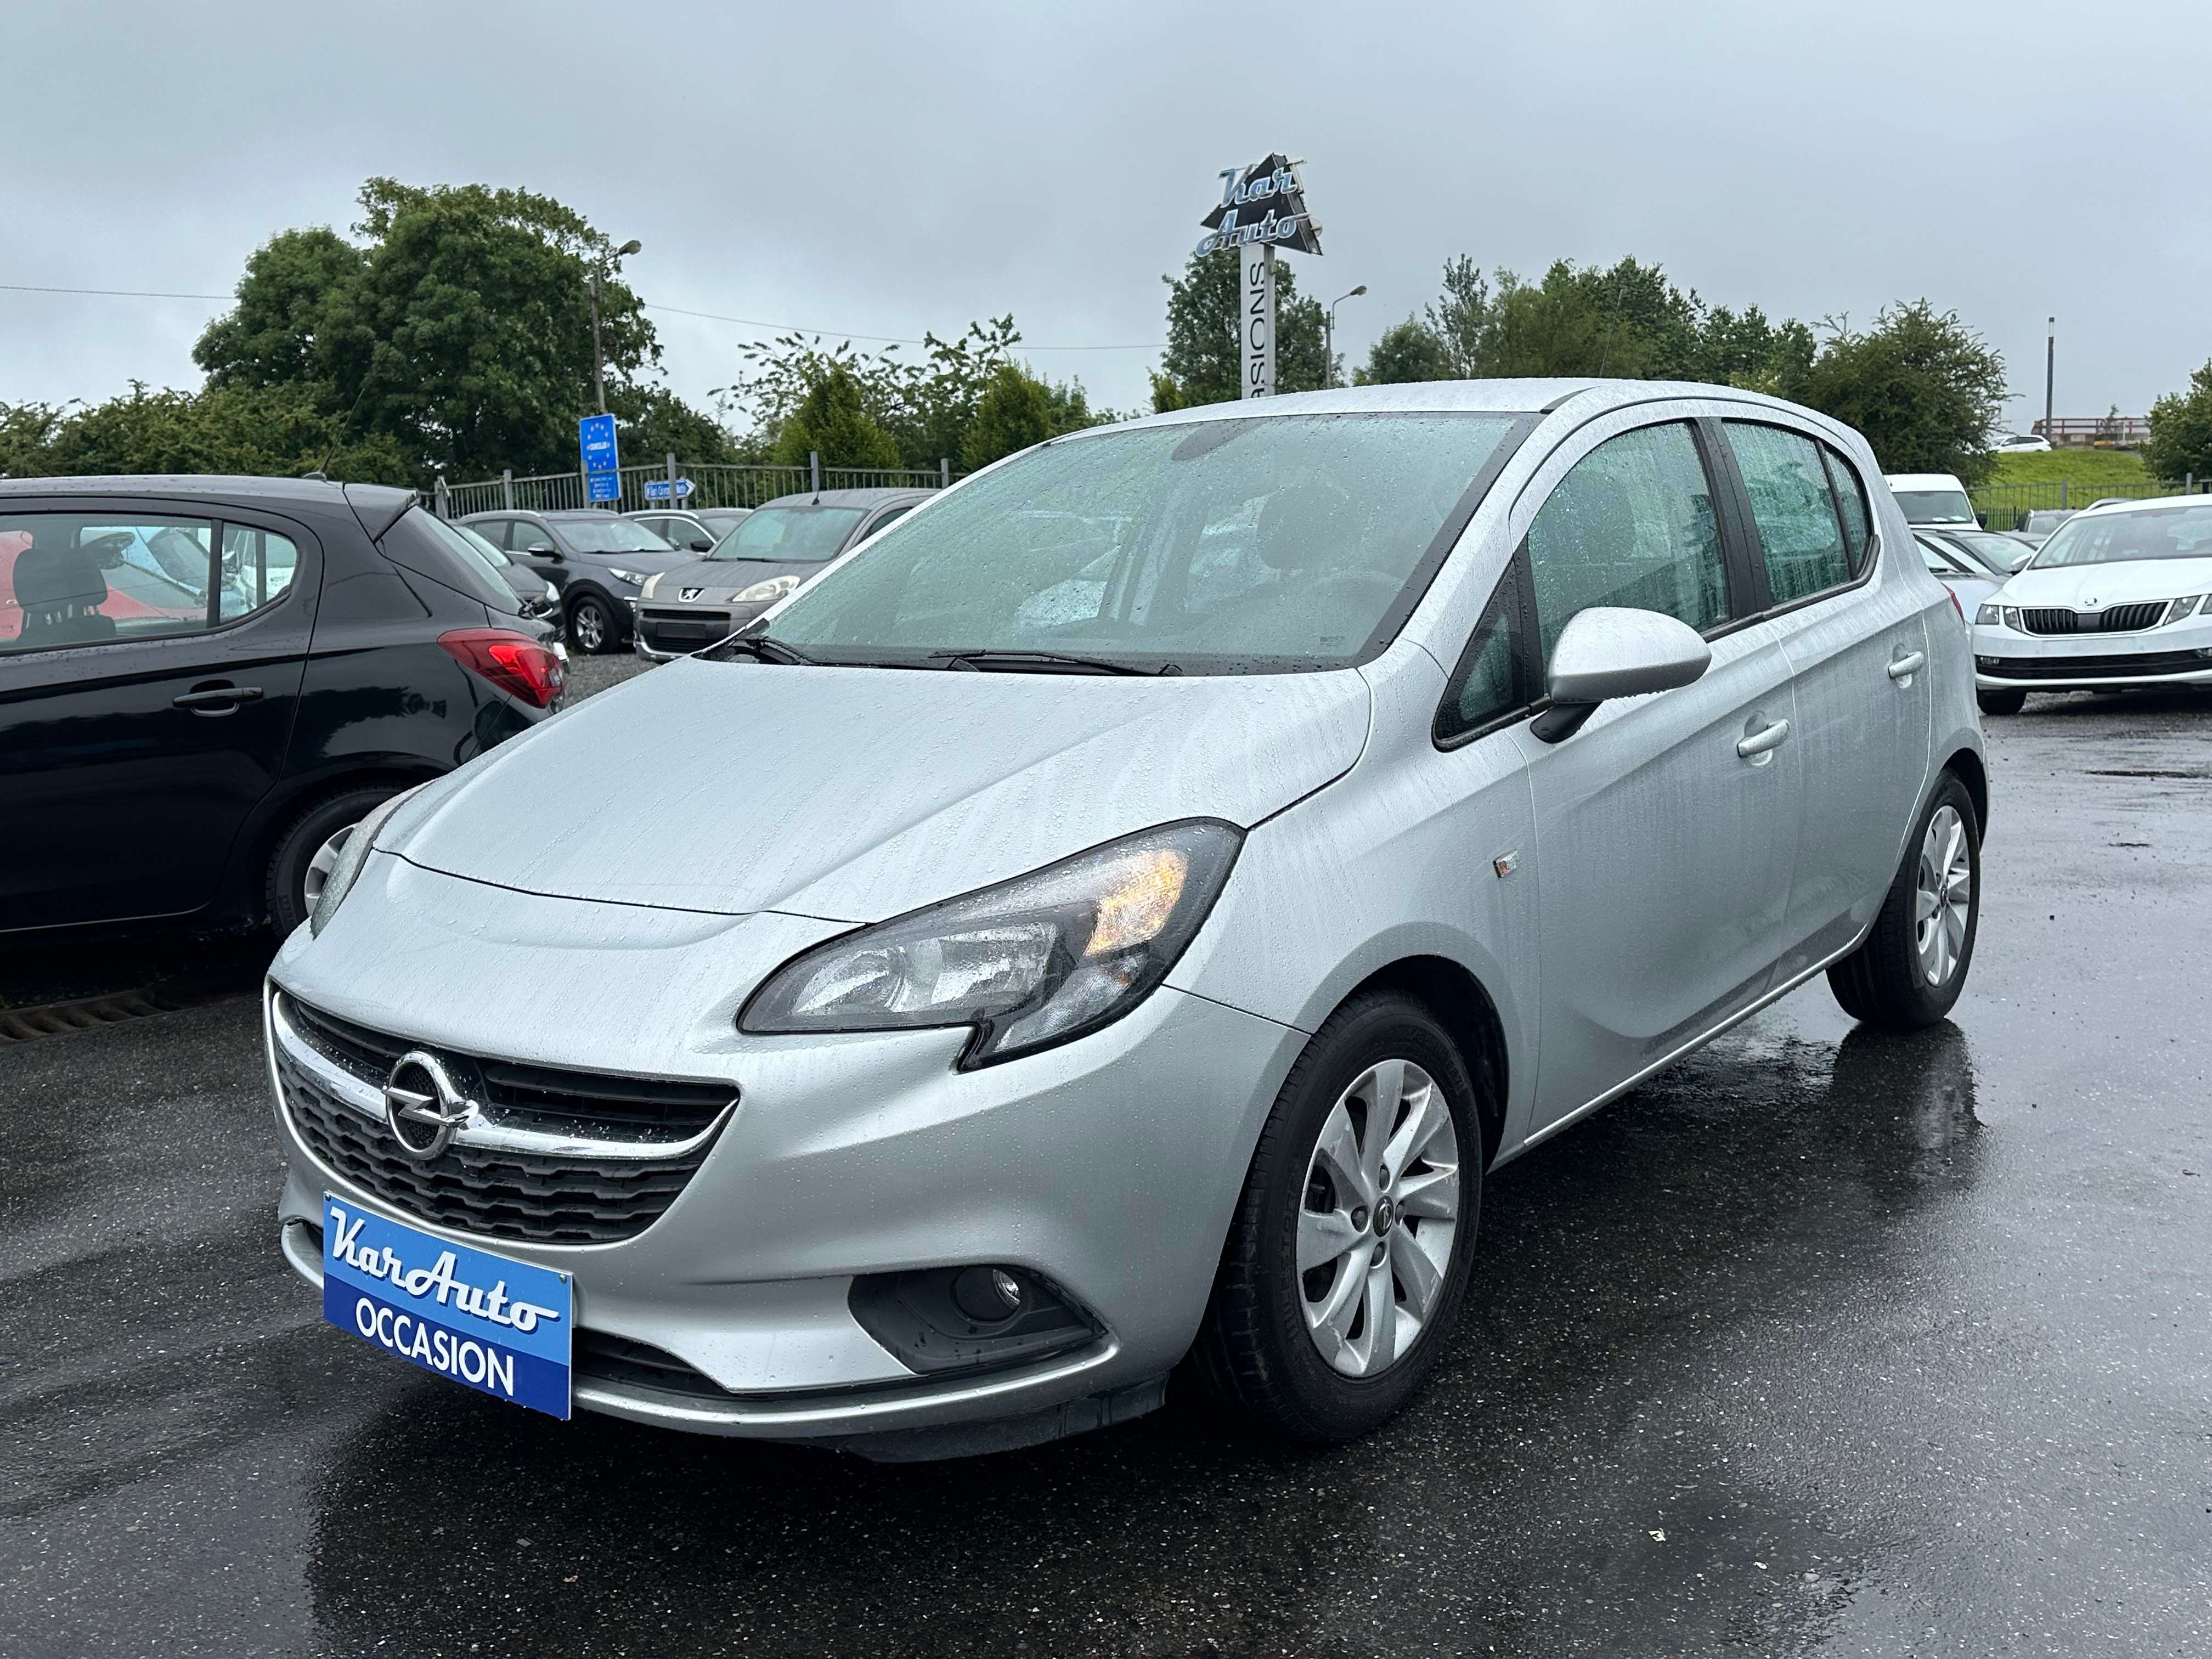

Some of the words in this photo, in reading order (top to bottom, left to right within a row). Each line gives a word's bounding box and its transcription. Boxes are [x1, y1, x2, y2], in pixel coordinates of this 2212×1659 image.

[1217, 163, 1297, 208] Kar
[1195, 209, 1310, 257] Auto
[356, 1297, 514, 1397] OCCASION
